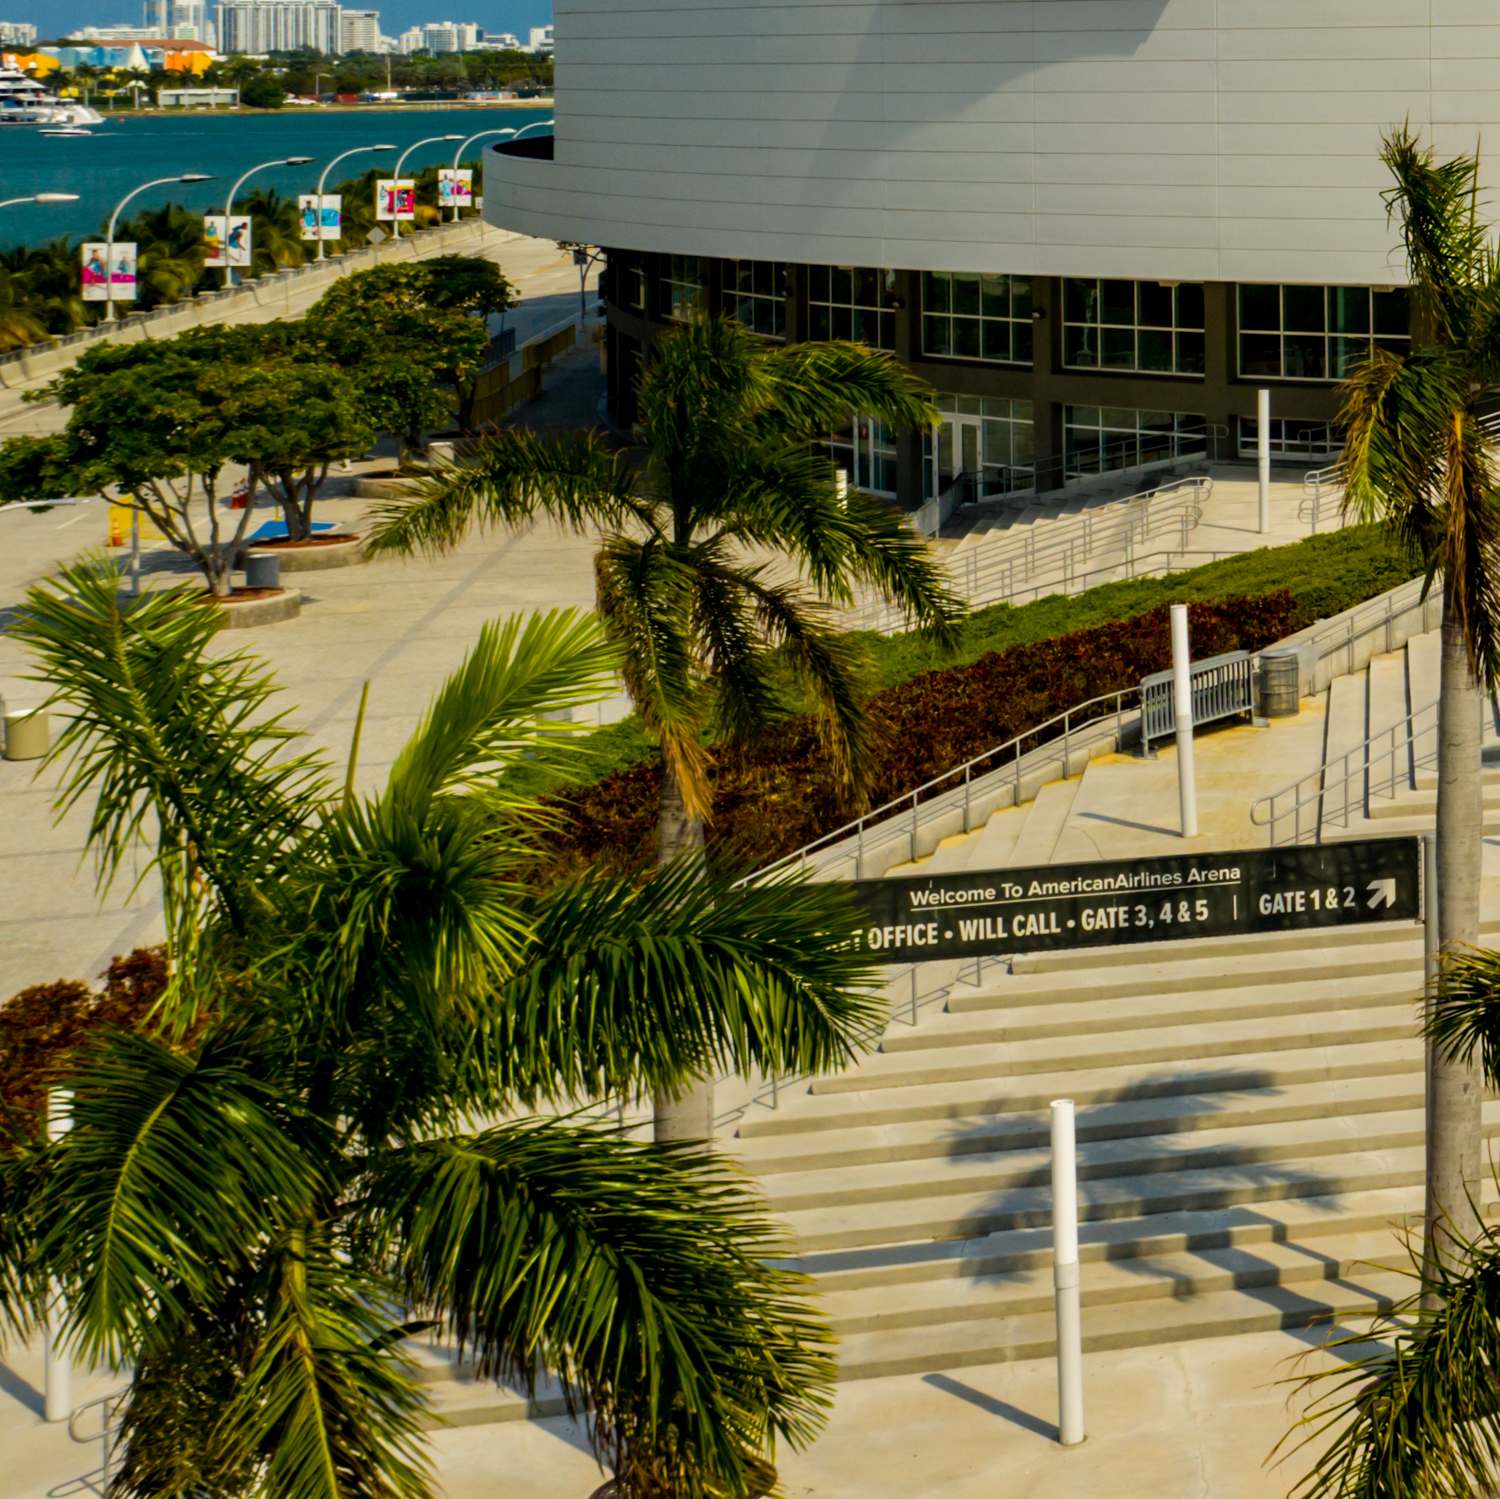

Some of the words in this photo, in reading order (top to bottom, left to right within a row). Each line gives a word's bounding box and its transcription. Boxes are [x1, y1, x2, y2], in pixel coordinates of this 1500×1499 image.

[910, 886, 996, 906] Welcome
[1001, 882, 1023, 898] To
[1028, 871, 1183, 897] AmericanAirlines
[1187, 866, 1241, 883] Arena
[1259, 889, 1305, 915] GATE
[1310, 888, 1320, 910] 1
[1325, 887, 1338, 909] &
[1343, 886, 1355, 908] 2
[868, 922, 938, 950] OFFICE
[959, 917, 1007, 941] WILL
[1013, 912, 1061, 937] CALL
[1081, 906, 1129, 931] GATE
[1134, 904, 1154, 929] 3,
[1159, 902, 1173, 924] 4
[1177, 900, 1191, 922] &
[1195, 899, 1209, 921] 5
